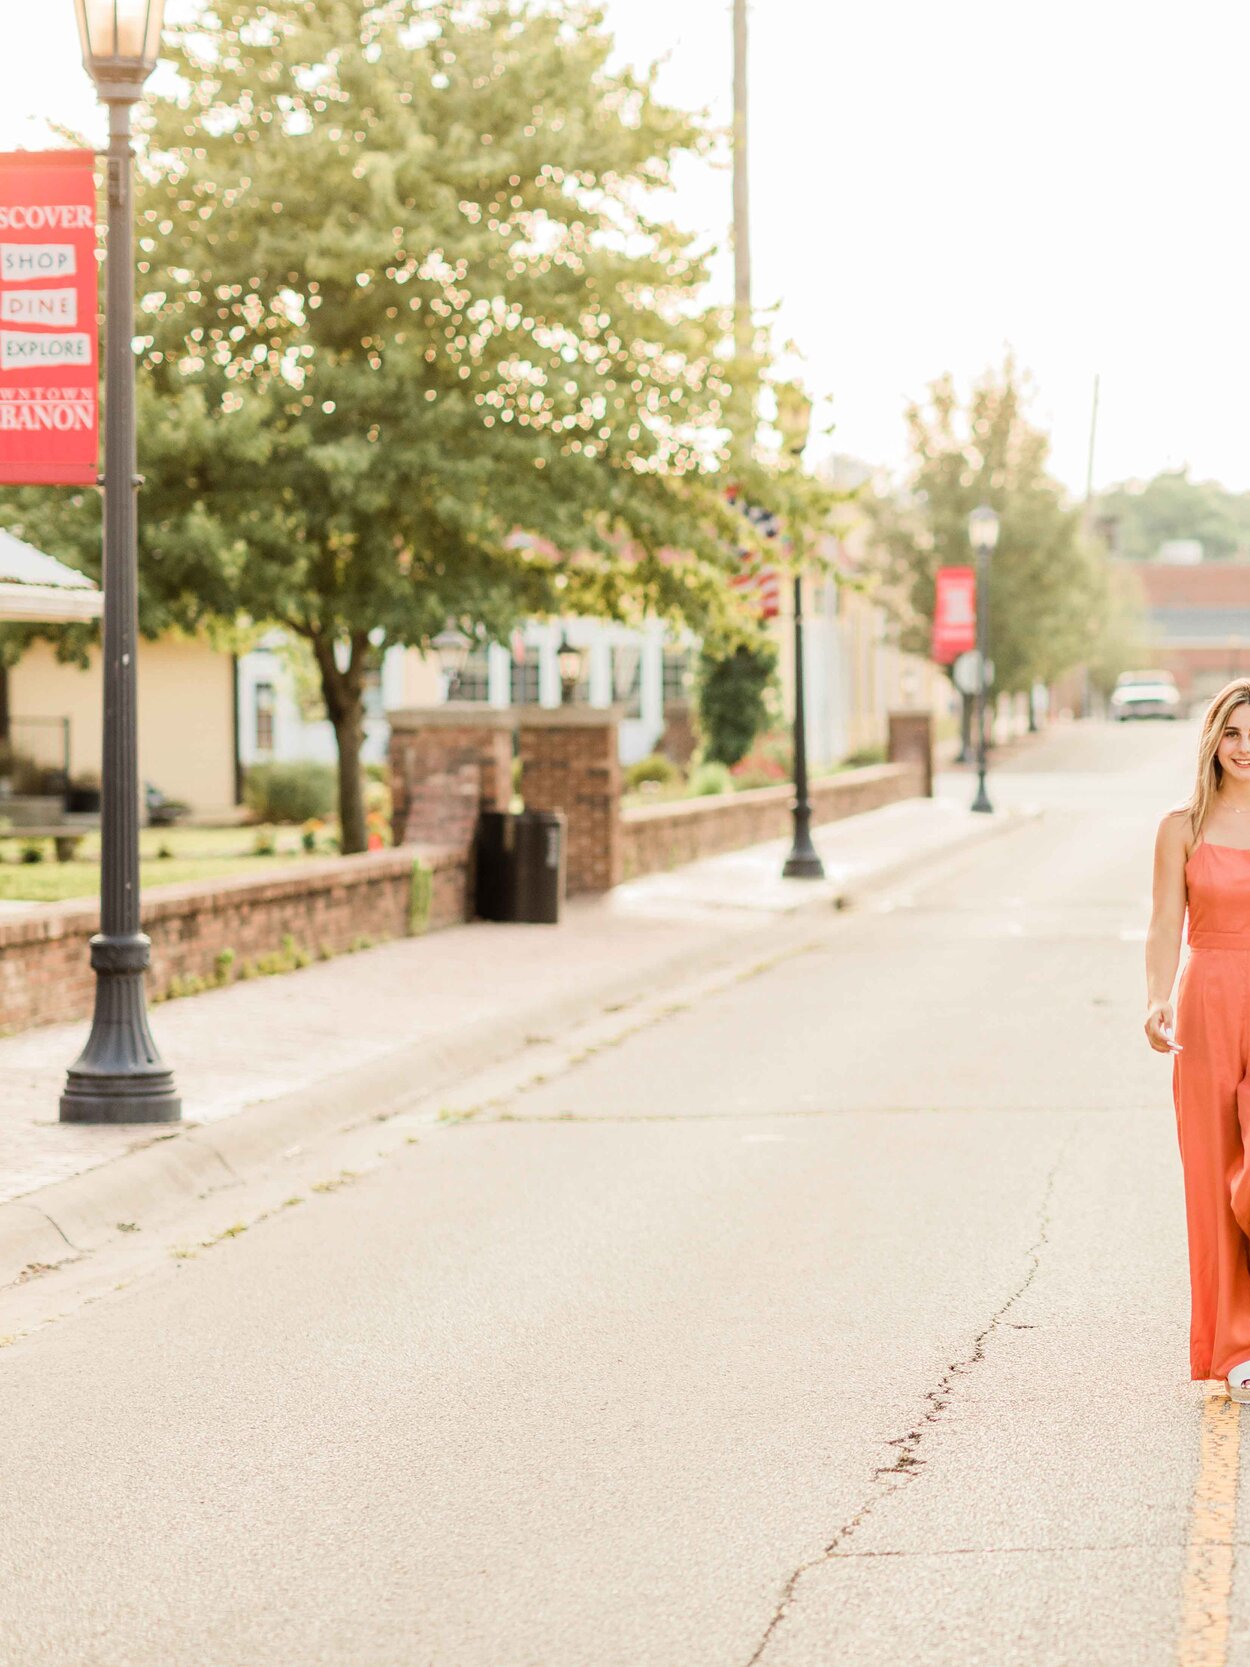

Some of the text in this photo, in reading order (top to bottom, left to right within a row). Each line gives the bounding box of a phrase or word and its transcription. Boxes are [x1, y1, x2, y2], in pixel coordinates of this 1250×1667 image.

[6, 252, 67, 269] SHOP
[10, 297, 68, 314] DINE
[7, 340, 84, 356] EXPLORE
[0, 403, 94, 431] BANON
